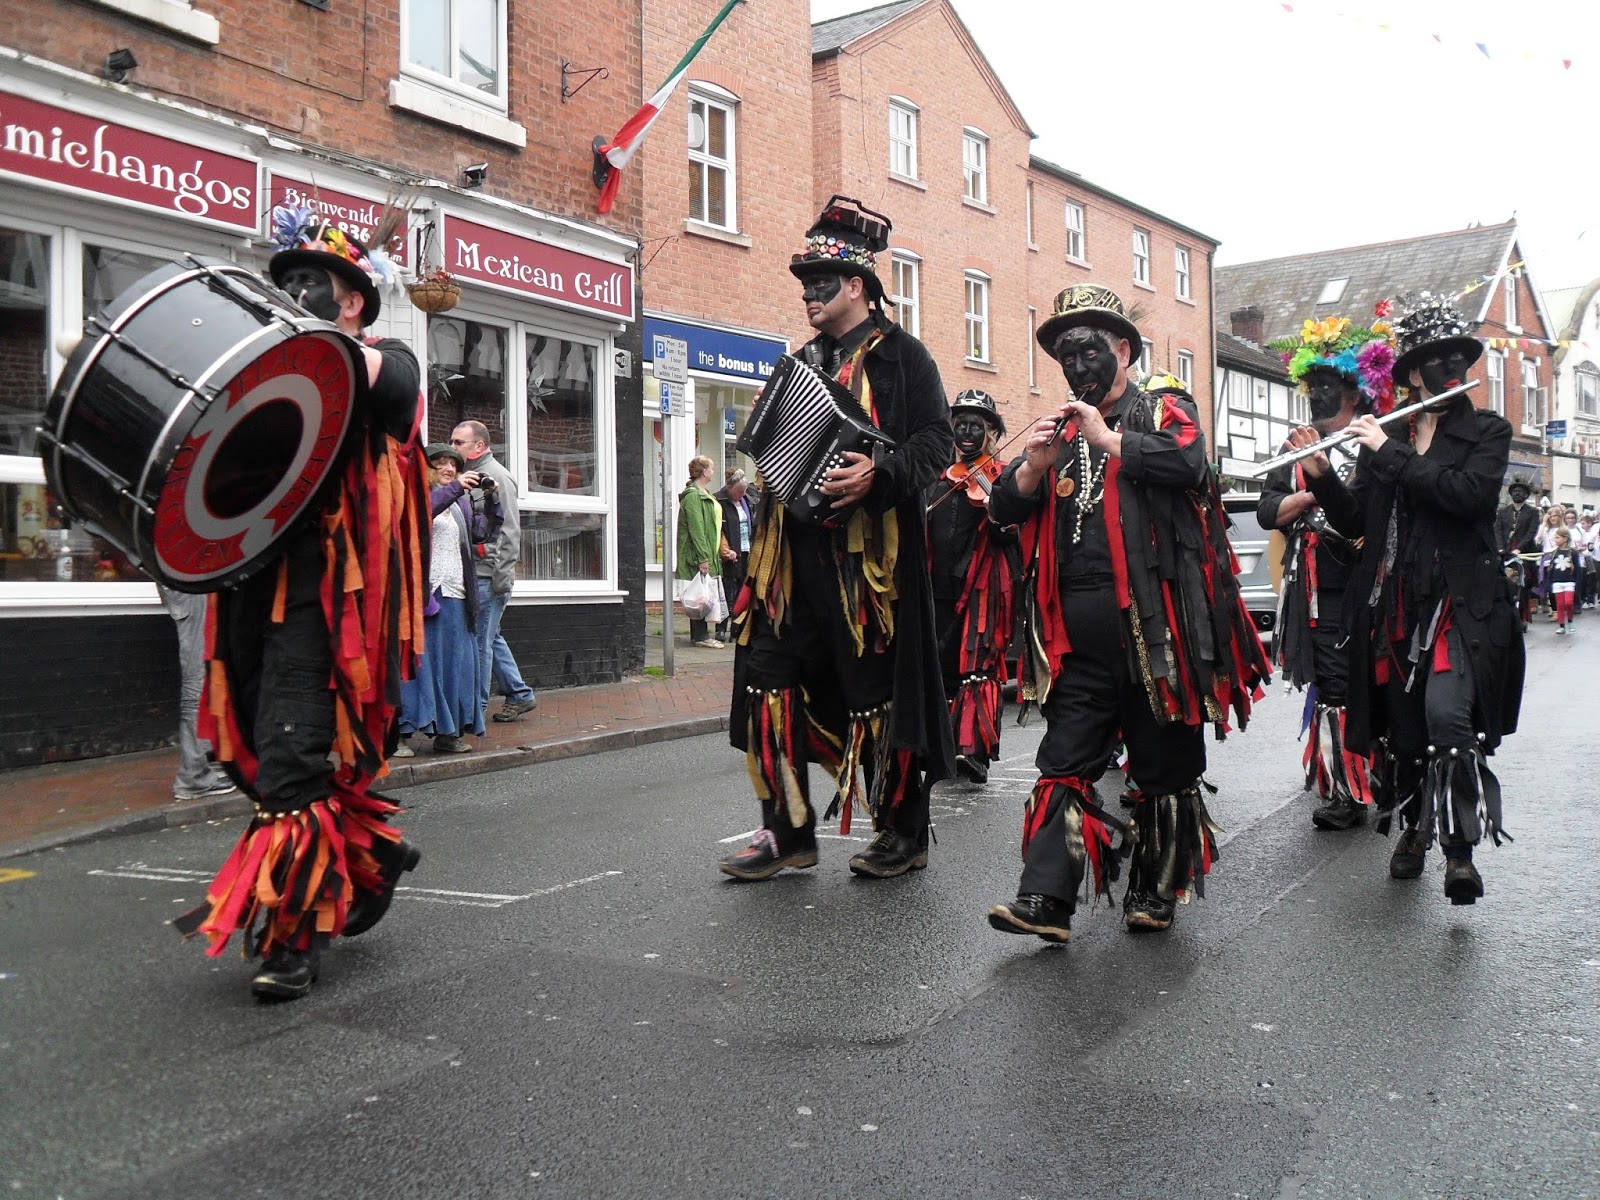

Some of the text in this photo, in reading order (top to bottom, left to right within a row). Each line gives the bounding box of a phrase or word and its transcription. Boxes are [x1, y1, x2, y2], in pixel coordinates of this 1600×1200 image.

[0, 110, 251, 216] michangos
[455, 238, 623, 307] Mexican Grill
[698, 350, 714, 366] the
[718, 353, 754, 373] bonus
